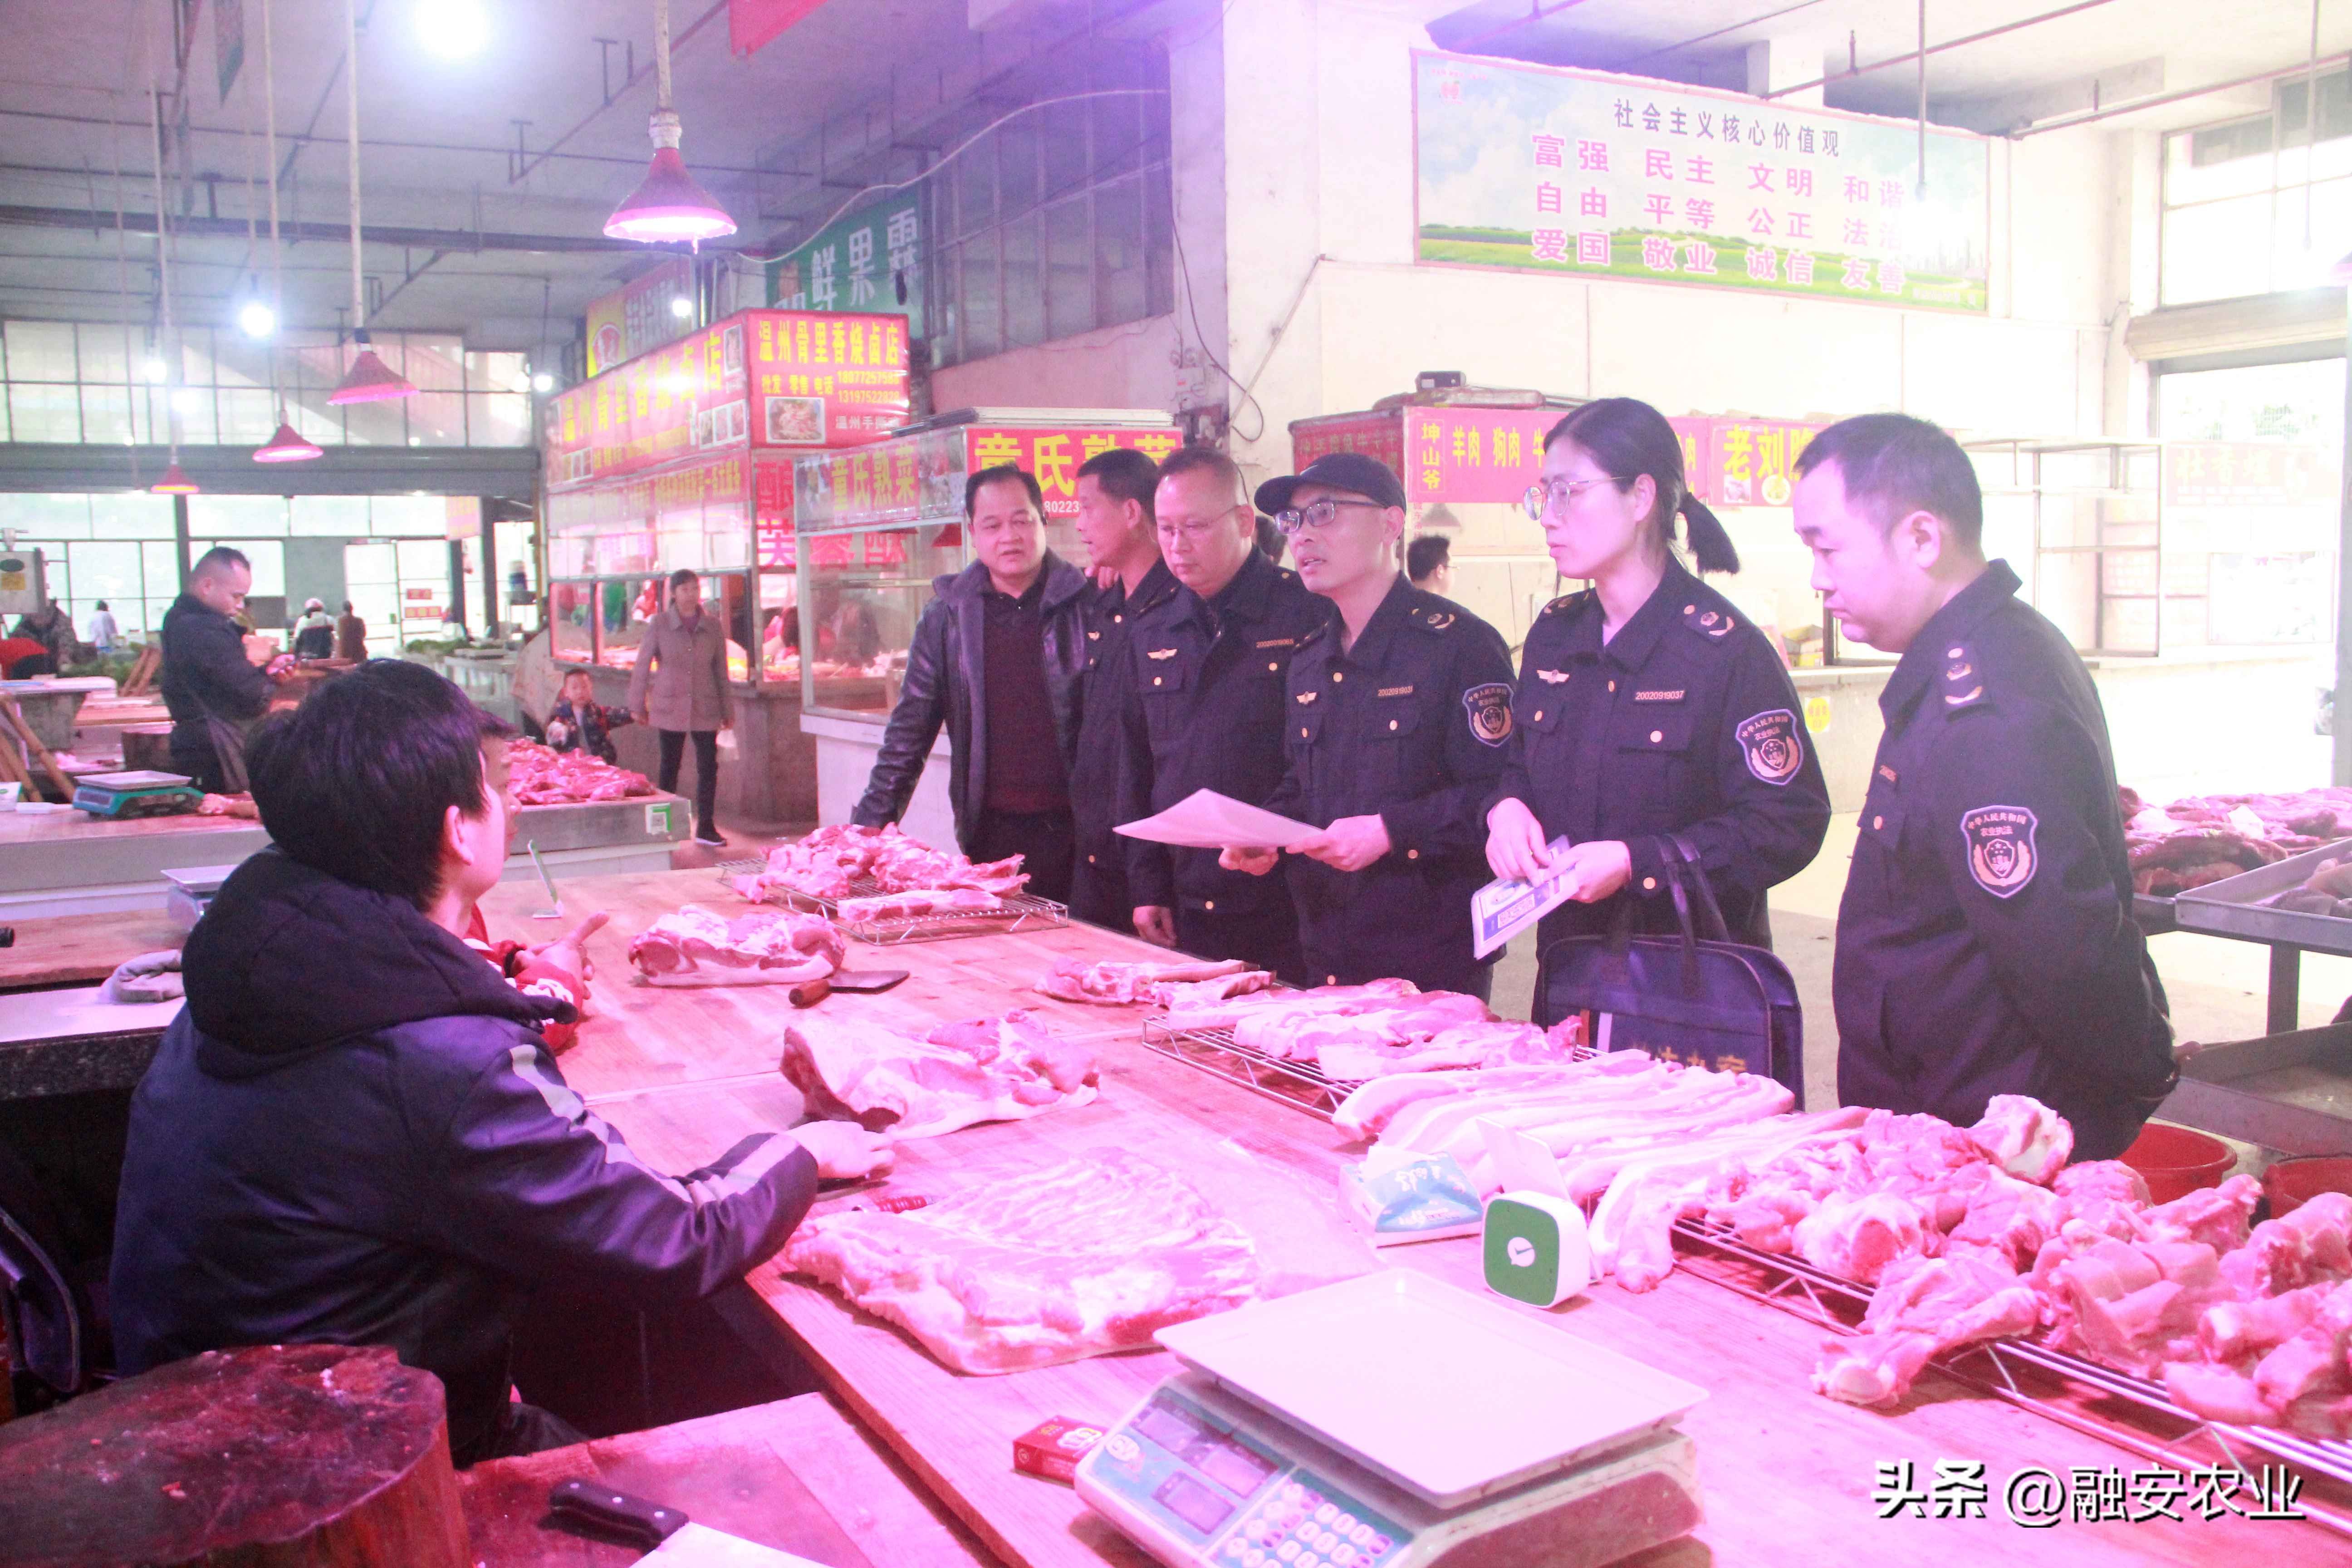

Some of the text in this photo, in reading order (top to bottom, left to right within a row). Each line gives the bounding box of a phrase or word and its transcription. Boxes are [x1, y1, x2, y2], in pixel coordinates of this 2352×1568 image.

[1614, 98, 1840, 157] 社会主义核心价值观
[1532, 134, 1904, 209] 富强 民主 文明 和谐
[1536, 181, 1903, 251] 自由 平等 公正 法治
[1532, 228, 1906, 294] 爱国 敬业 诚信 友善
[759, 320, 899, 366] 温州骨里香烧卤店
[814, 375, 834, 395] 电话
[1421, 422, 1441, 490] 坤山爷
[1452, 425, 1480, 468] 羊肉
[1492, 425, 1520, 468] 狗肉
[831, 445, 916, 511] 童氏熟菜
[1044, 500, 1082, 513] 80223
[1636, 690, 1685, 700] 20020919037
[1968, 812, 2027, 830] 中华人民共和国
